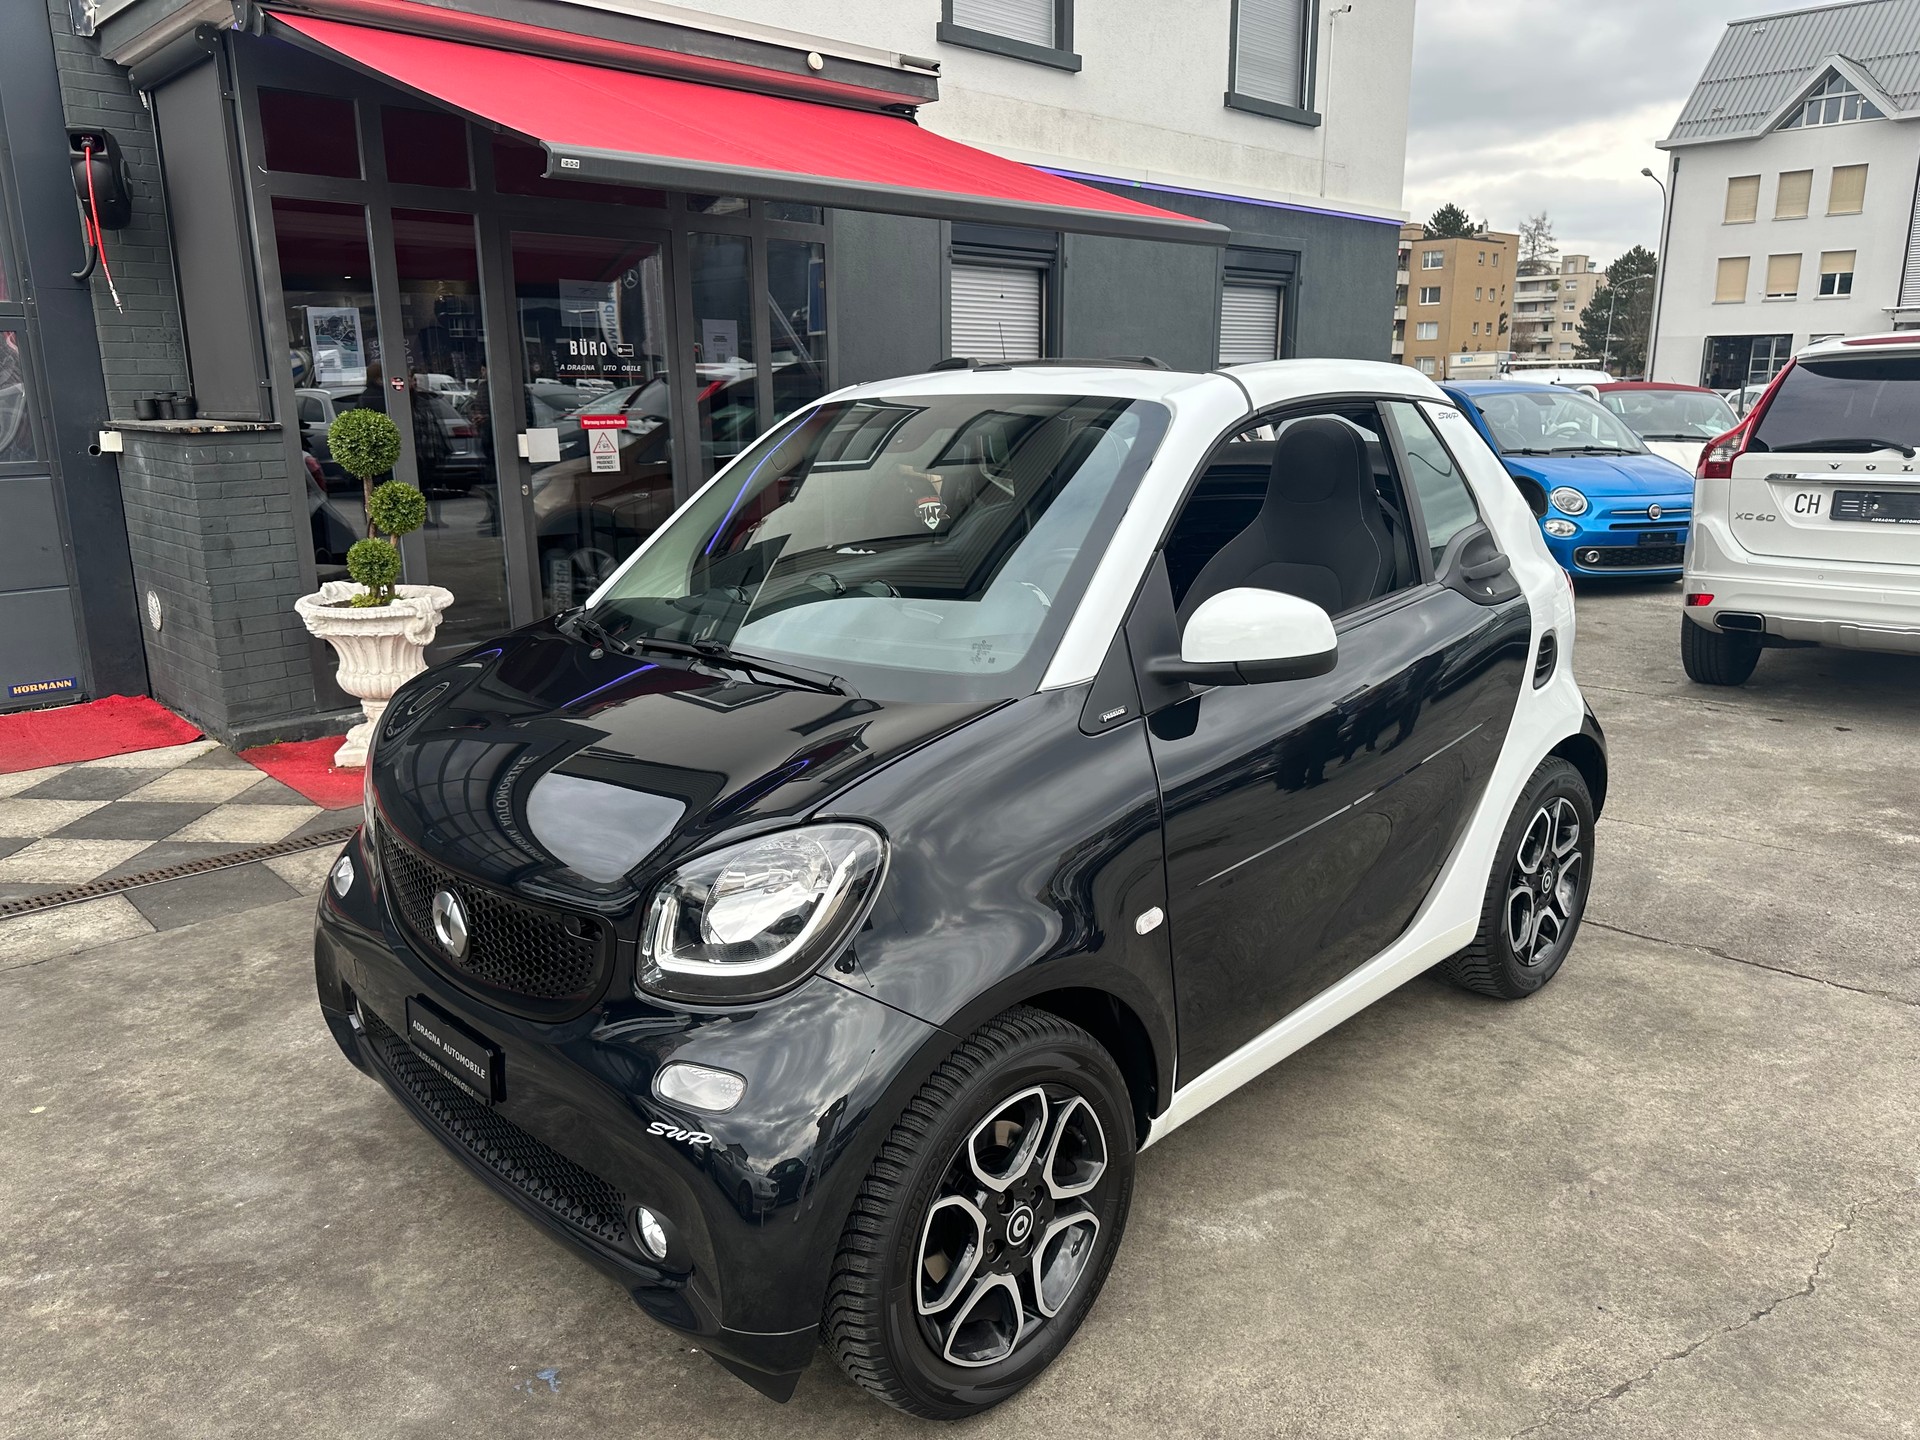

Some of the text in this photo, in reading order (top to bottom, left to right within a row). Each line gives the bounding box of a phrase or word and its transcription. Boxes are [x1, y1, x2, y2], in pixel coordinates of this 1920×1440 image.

[569, 338, 607, 356] BÜRO
[1438, 412, 1459, 420] SWP
[1793, 494, 1822, 514] CH
[1103, 708, 1125, 722] passion
[412, 1020, 486, 1079] ADRAGNA AUTOMOBILE
[646, 1121, 713, 1145] SWP
